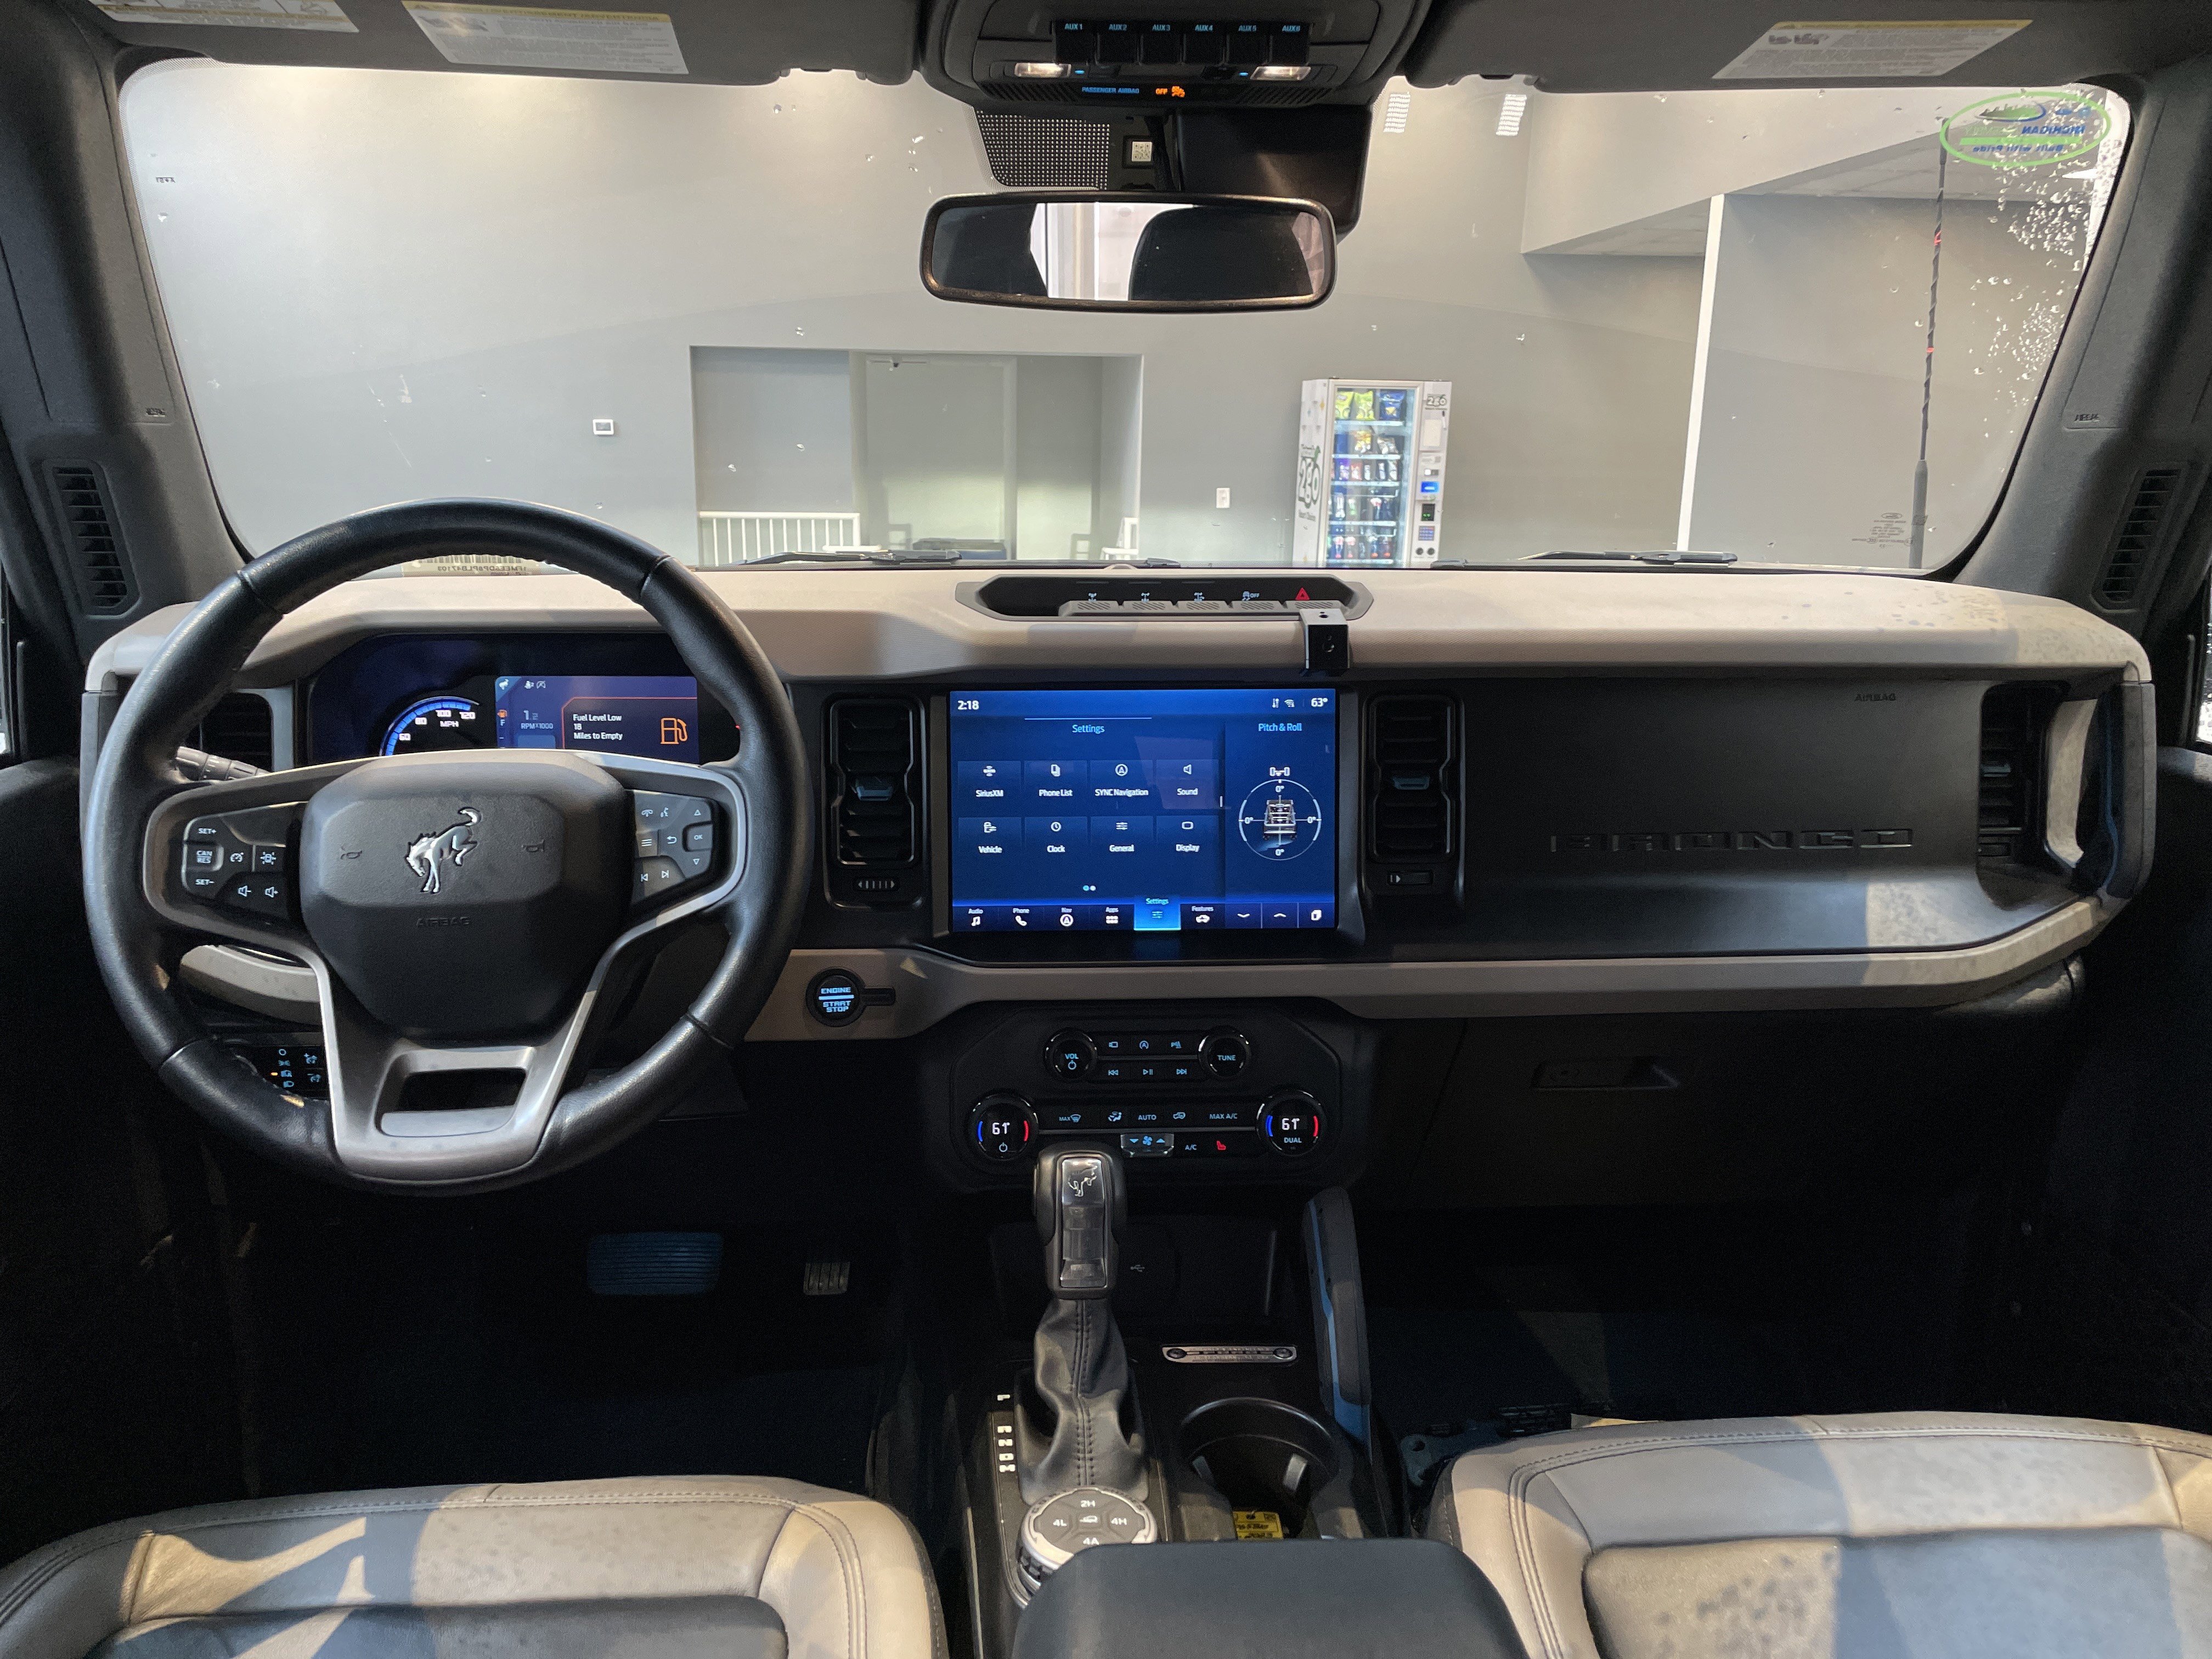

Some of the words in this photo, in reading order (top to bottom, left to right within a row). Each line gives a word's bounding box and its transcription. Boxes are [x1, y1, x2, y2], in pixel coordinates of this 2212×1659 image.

[957, 700, 979, 710] 2:18
[1311, 697, 1328, 707] 63°
[1072, 724, 1105, 734] Settings
[1258, 723, 1278, 731] Pitch
[1287, 723, 1302, 731] Roll
[601, 732, 623, 741] Empty
[1114, 789, 1149, 798] Navigation
[1550, 828, 1914, 853] BRONCO
[1176, 844, 1200, 853] Display
[1082, 1537, 1099, 1545] 4A
